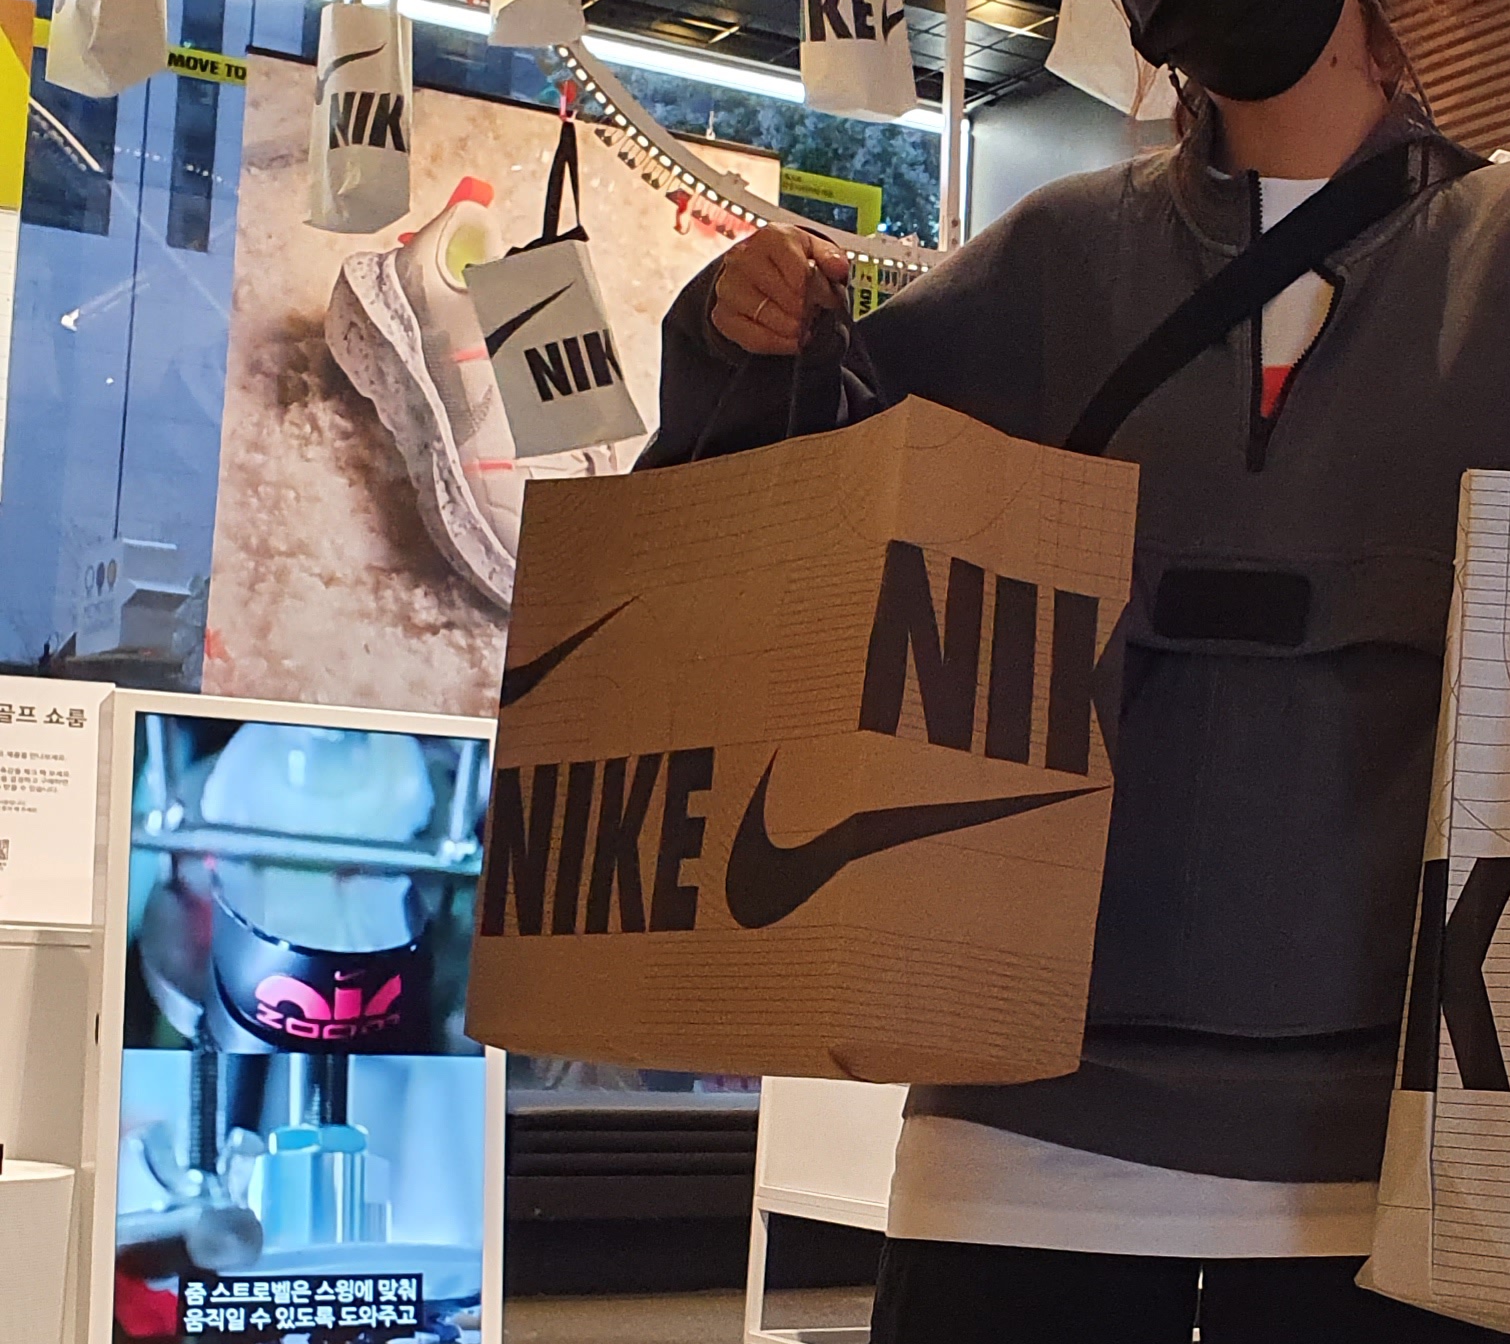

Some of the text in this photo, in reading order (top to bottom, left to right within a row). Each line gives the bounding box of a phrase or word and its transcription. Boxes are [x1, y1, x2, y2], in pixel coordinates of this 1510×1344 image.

[168, 53, 247, 80] MOVE TO
[329, 91, 408, 152] NIK
[0, 703, 88, 729] 골프 쇼룸
[481, 746, 715, 937] NIKE
[184, 1278, 417, 1306] 줌 스트로벨은 스윙에 맞춰
[183, 1305, 417, 1332] 움직일 수 있도록 도와주고
